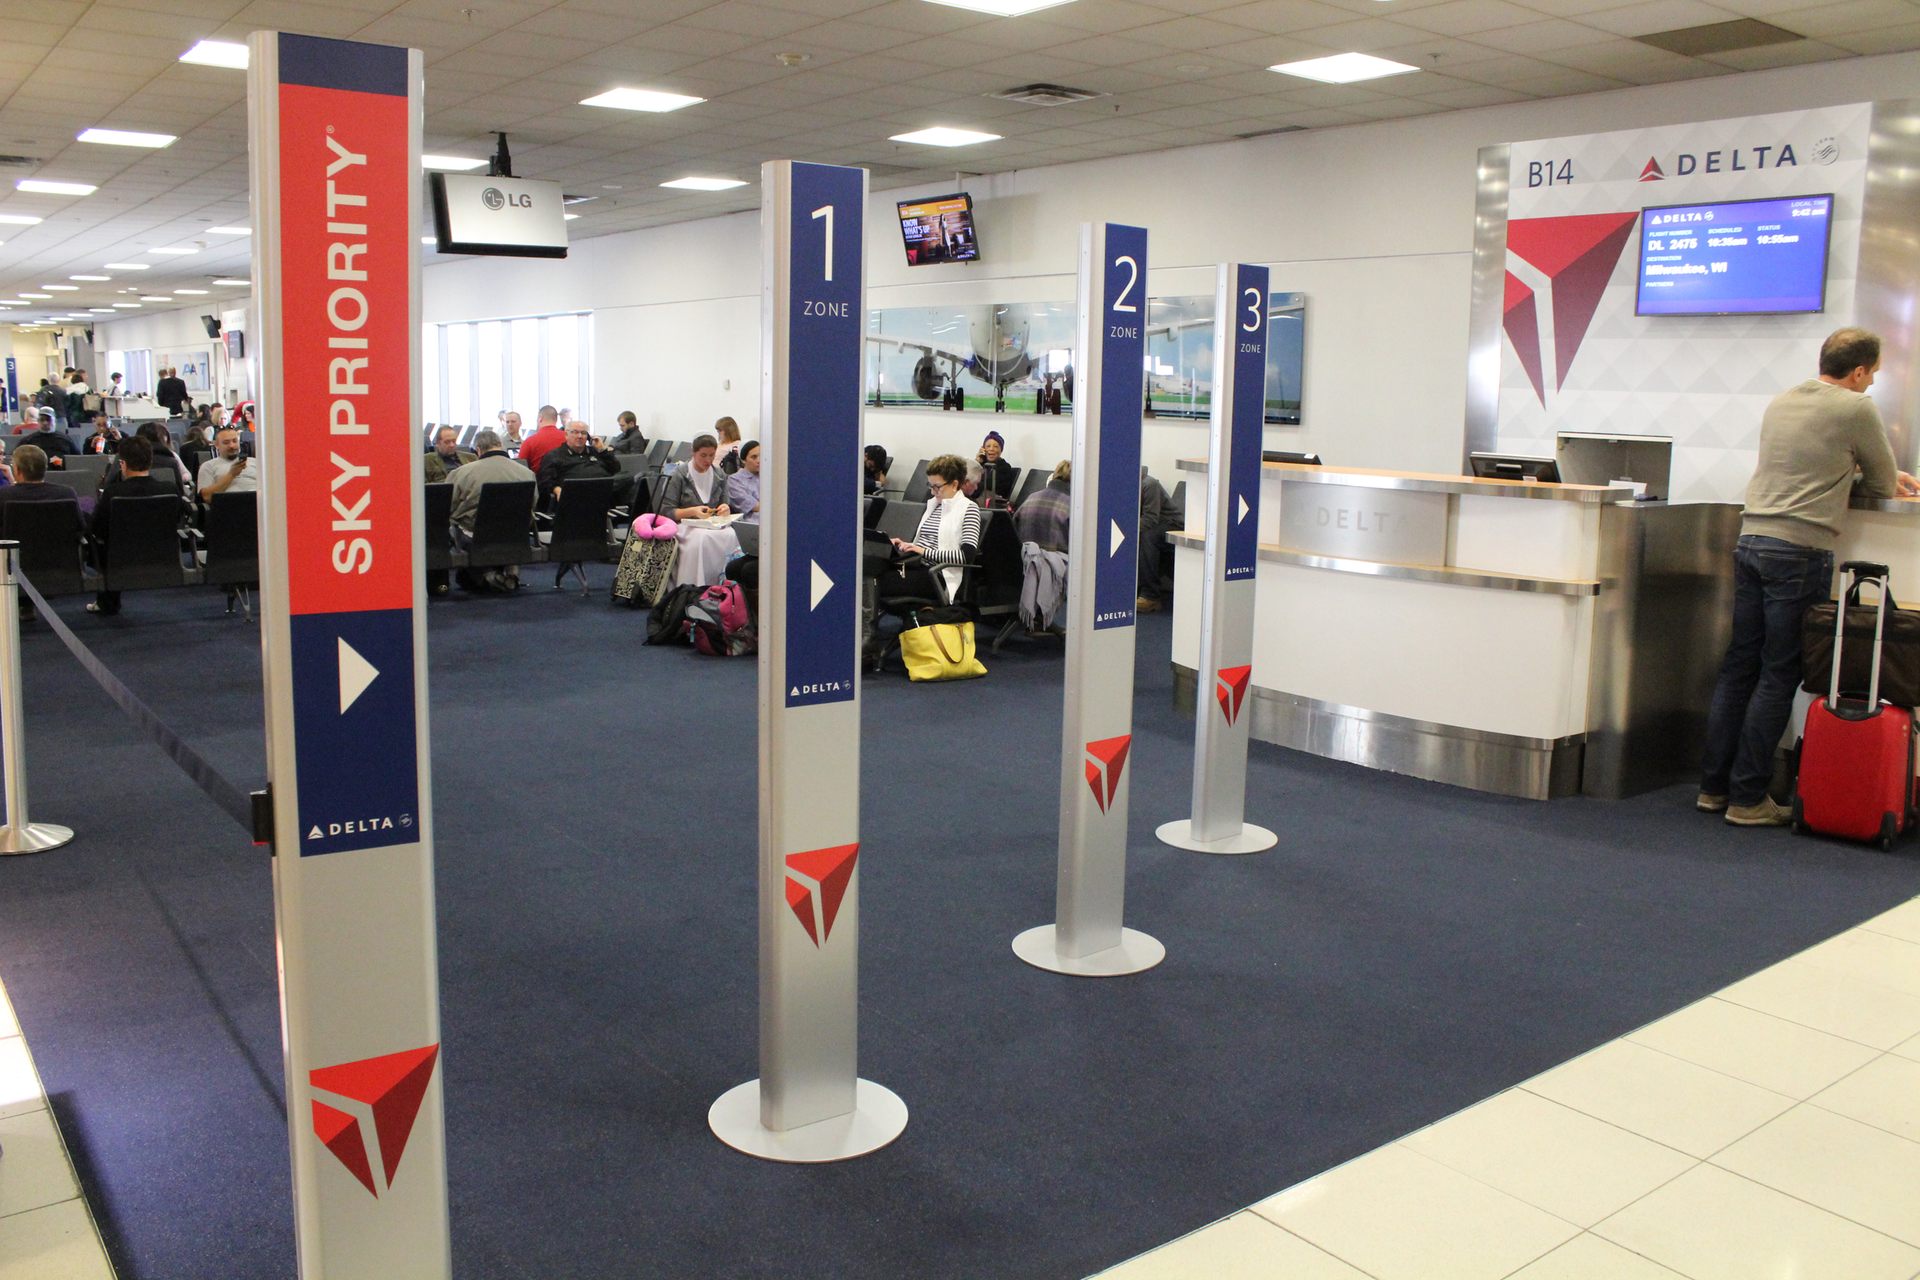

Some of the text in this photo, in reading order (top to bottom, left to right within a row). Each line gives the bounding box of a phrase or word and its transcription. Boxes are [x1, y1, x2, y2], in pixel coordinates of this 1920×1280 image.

[1678, 144, 1798, 176] DELTA
[1528, 158, 1575, 188] B14
[508, 193, 532, 208] LG
[1791, 200, 1811, 208] LOCAL
[1663, 212, 1702, 223] DELTA
[1811, 208, 1825, 216] am
[811, 205, 834, 282] 1
[1648, 238, 1698, 251] DL 2475
[1646, 261, 1728, 275] Milwaukee, WI
[1112, 255, 1138, 313] 2
[803, 300, 849, 318] ZONE
[1242, 287, 1261, 332] 3
[1110, 325, 1138, 339] ZONE
[1240, 343, 1261, 354] ZONE
[8, 361, 14, 370] 3
[331, 450, 373, 575] SKY
[1317, 507, 1397, 532] DELT
[1232, 566, 1249, 574] DELTA
[1104, 611, 1127, 621] DELTA
[803, 682, 840, 694] DELTA
[330, 817, 393, 835] DELTA
